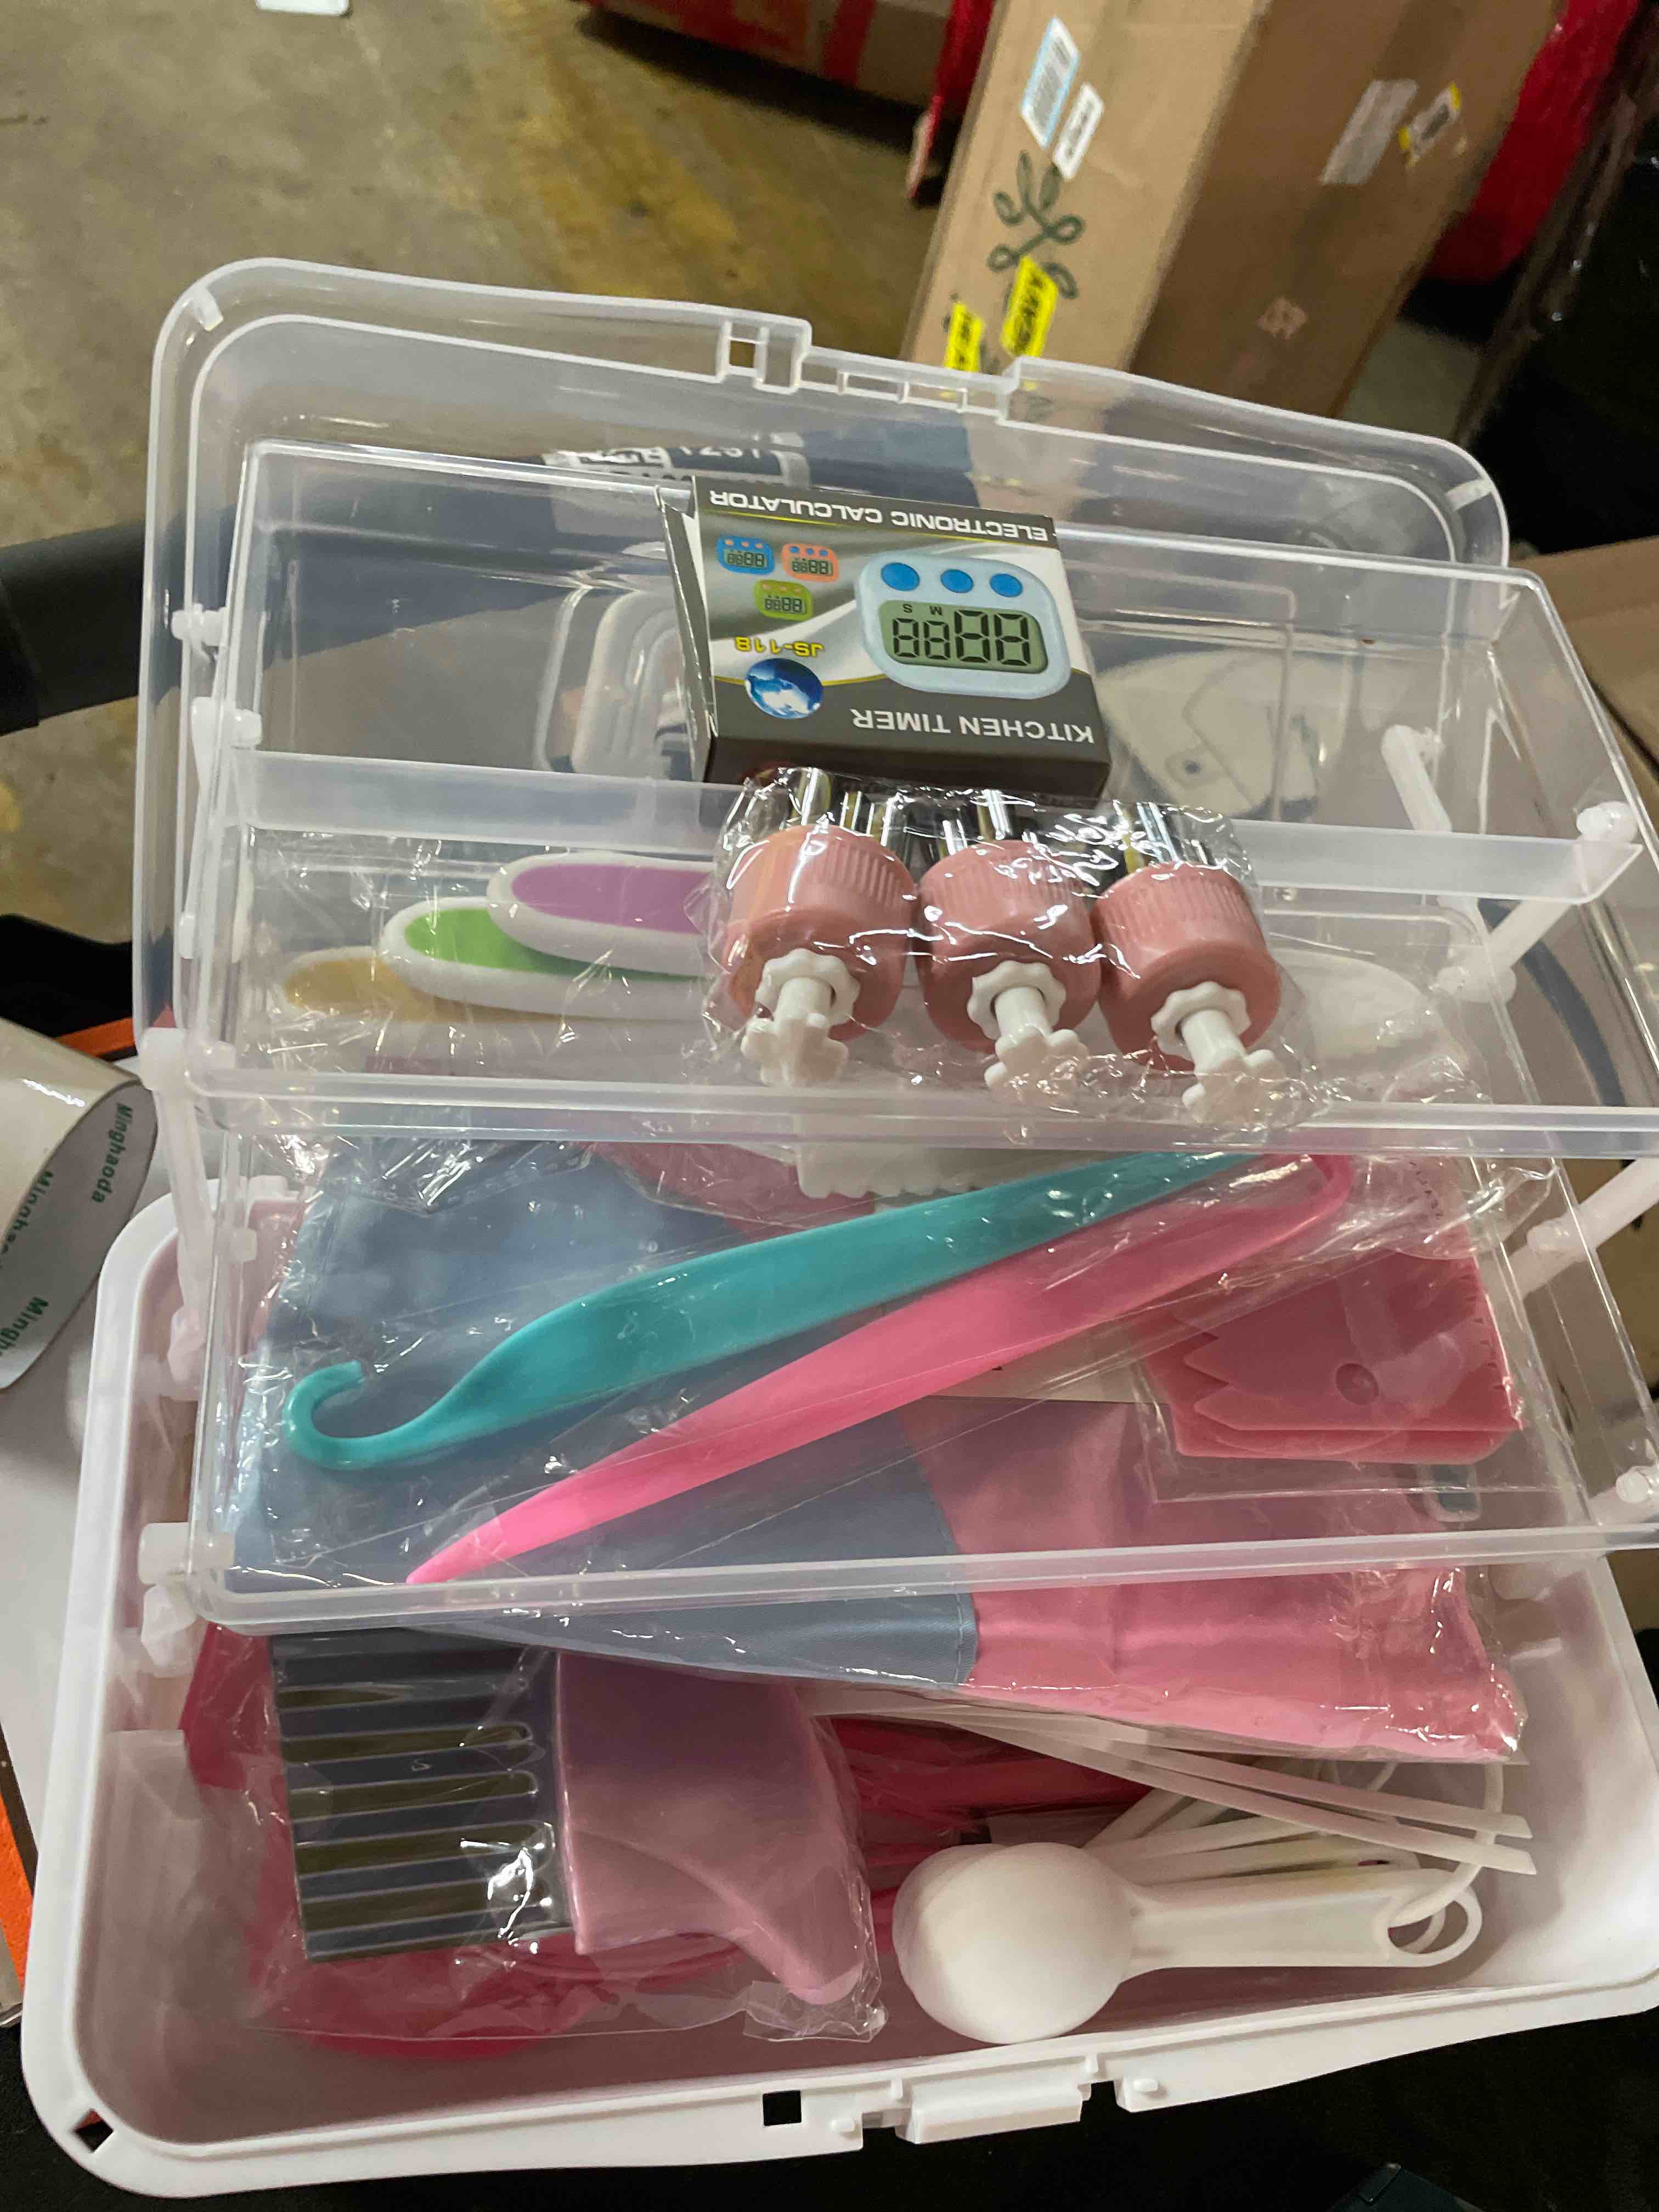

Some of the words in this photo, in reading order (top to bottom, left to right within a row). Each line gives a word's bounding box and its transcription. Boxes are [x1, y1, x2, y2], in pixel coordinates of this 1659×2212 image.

[709, 490, 883, 523] CALCULATOR
[890, 511, 1048, 541] ELECTRONIC
[902, 603, 913, 613] S
[929, 605, 943, 616] M
[734, 636, 825, 657] JS-118
[850, 708, 951, 733] TIMER
[958, 715, 1095, 743] KITCHEN
[92, 1103, 133, 1203] Minghaoda
[0, 1296, 49, 1357] Mingh
